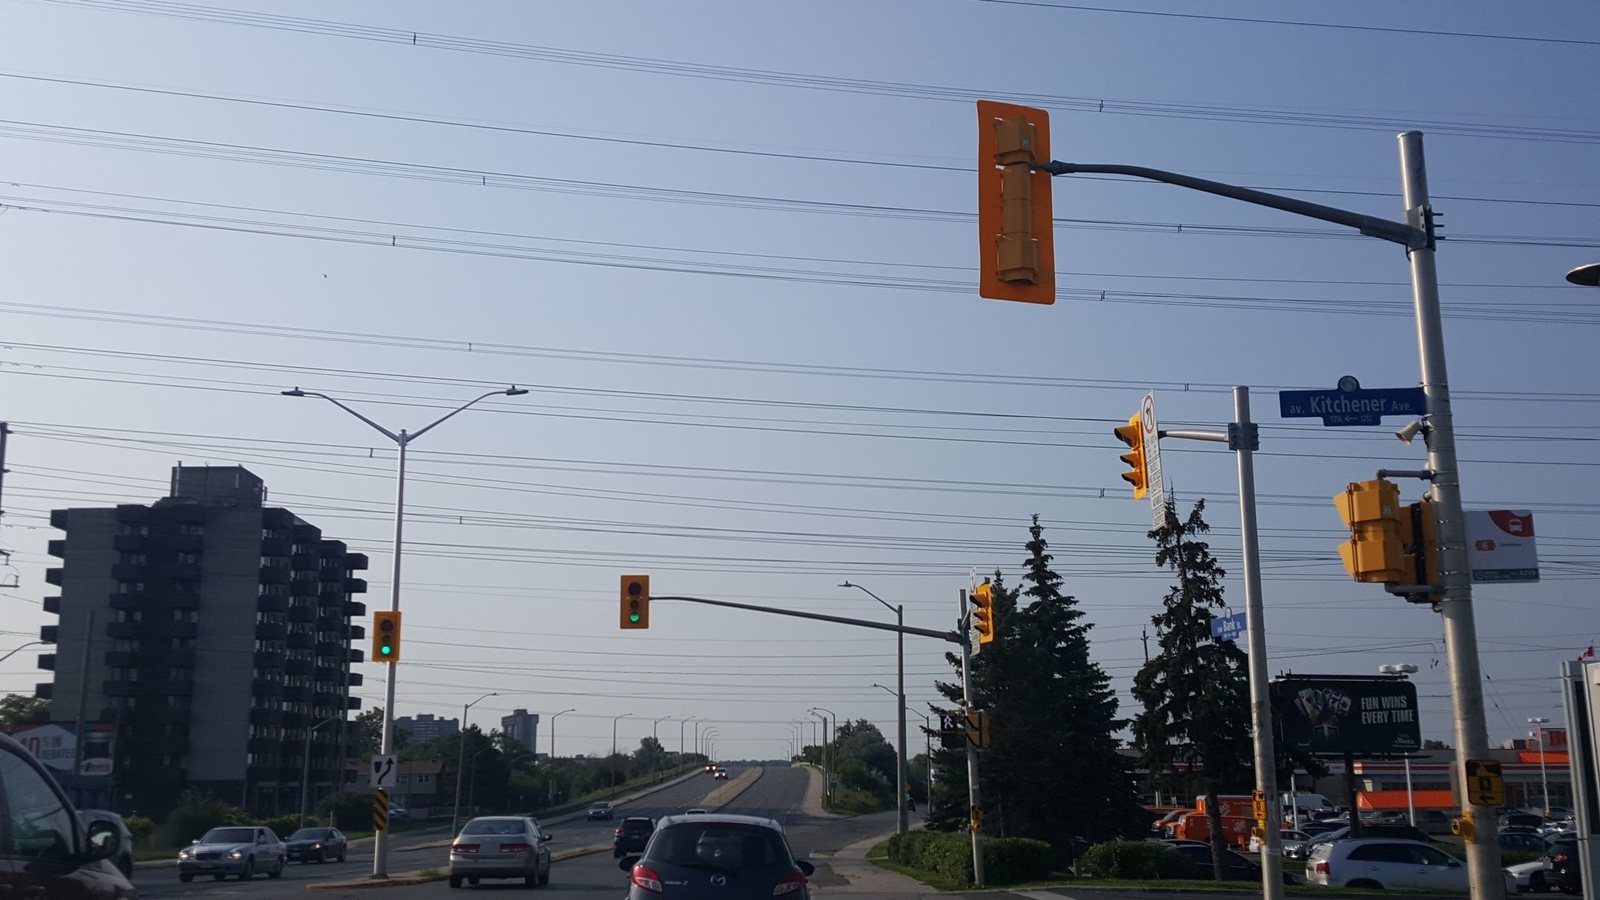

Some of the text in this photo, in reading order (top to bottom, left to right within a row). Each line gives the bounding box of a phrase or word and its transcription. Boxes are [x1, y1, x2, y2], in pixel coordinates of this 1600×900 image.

[1290, 395, 1414, 414] av. Kitchener Ave.
[1361, 695, 1407, 710] FUN WINS
[1361, 710, 1415, 724] EVERY TIME
